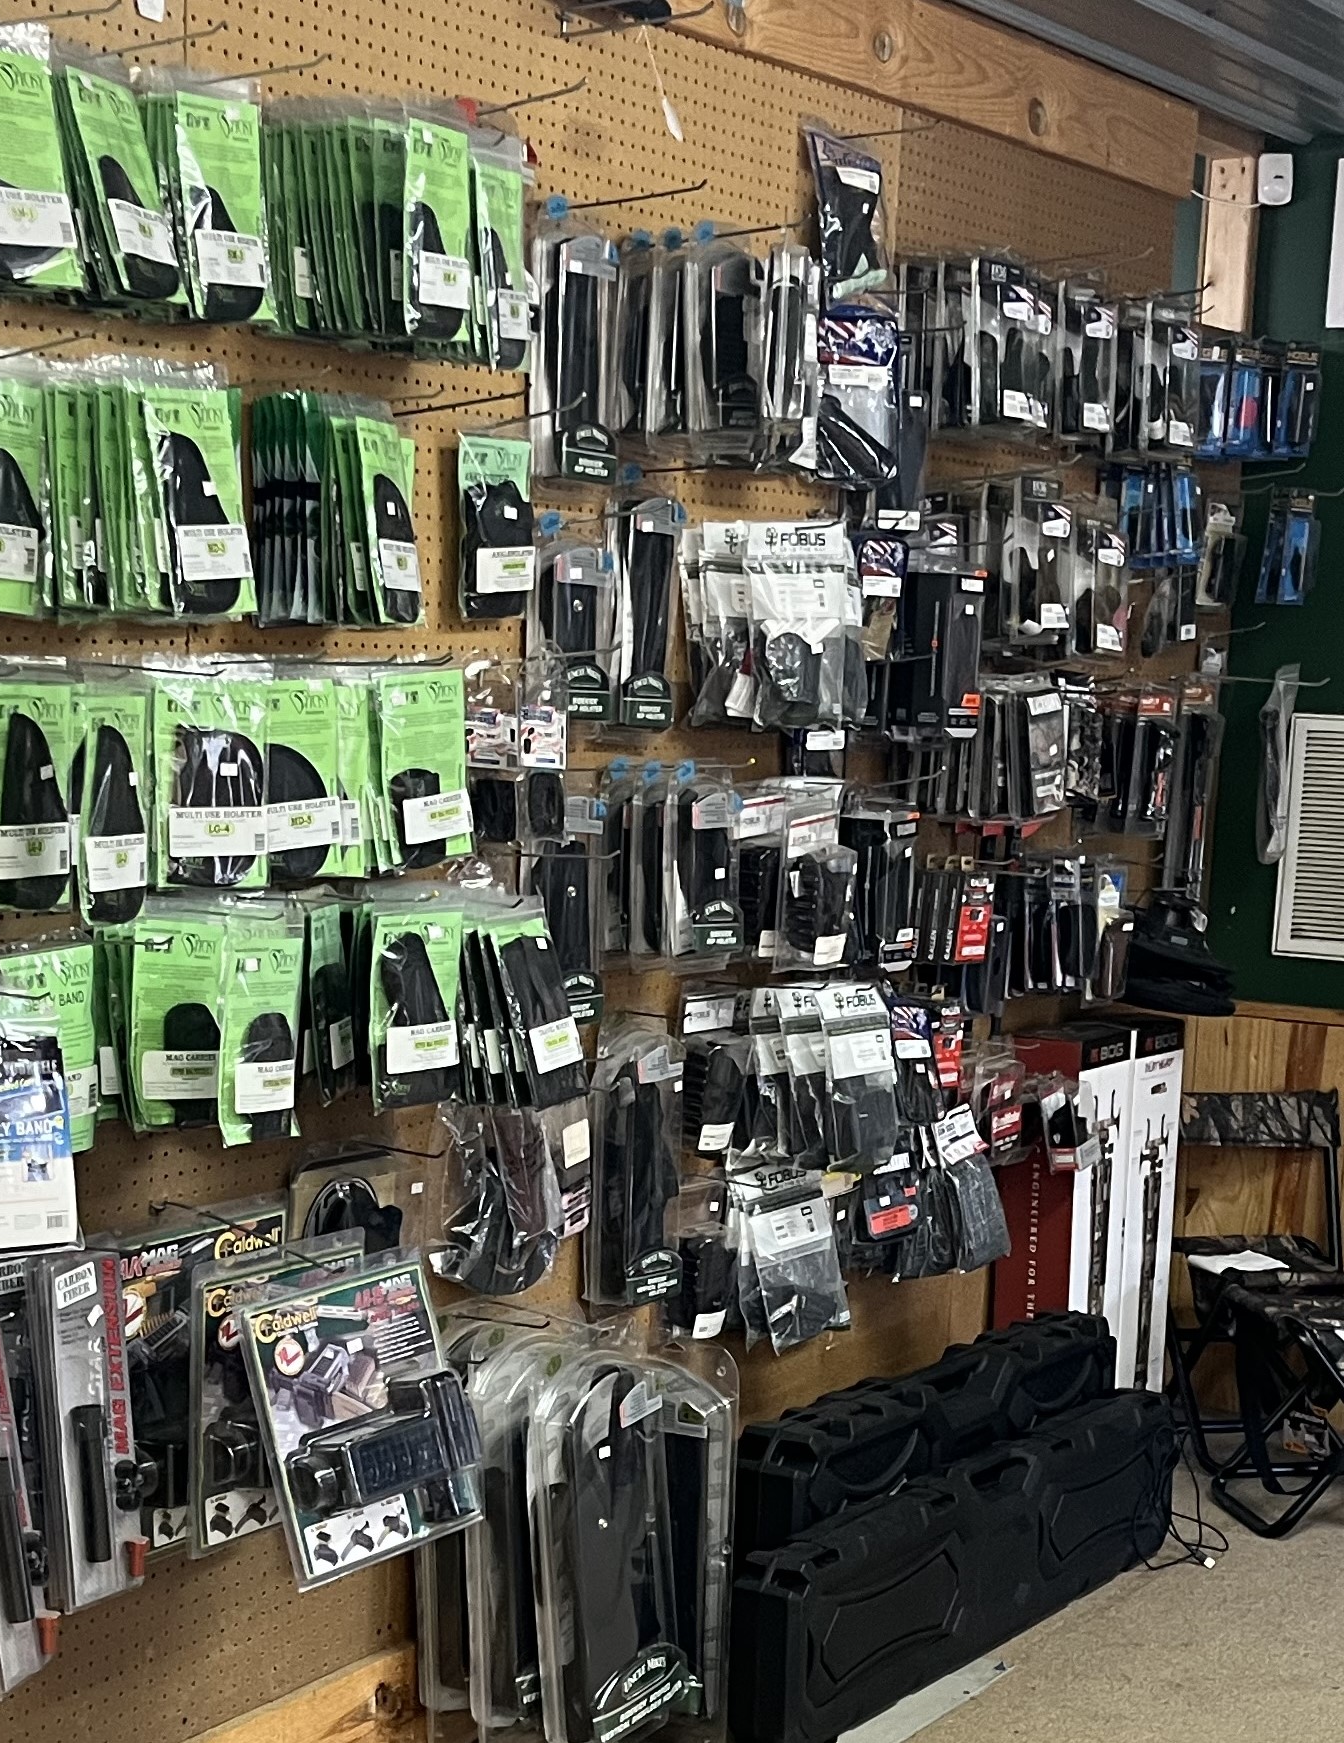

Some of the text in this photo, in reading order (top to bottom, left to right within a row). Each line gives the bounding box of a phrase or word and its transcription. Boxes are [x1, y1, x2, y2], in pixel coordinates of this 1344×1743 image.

[780, 532, 825, 546] FOBUS
[176, 810, 262, 820] MULTI USE HOLSTER
[59, 990, 84, 1007] BAND
[846, 994, 877, 1008] FOBUS
[17, 1119, 53, 1138] BAND
[768, 1168, 806, 1187] FOBUS
[214, 1227, 282, 1261] Caldwell
[140, 1245, 179, 1267] MAG
[57, 1266, 94, 1290] CARBON
[1028, 1260, 1037, 1286] FOR
[1026, 1292, 1036, 1320] THE
[256, 1305, 318, 1343] Caldwell
[102, 1258, 131, 1455] MAG EXTENSION
